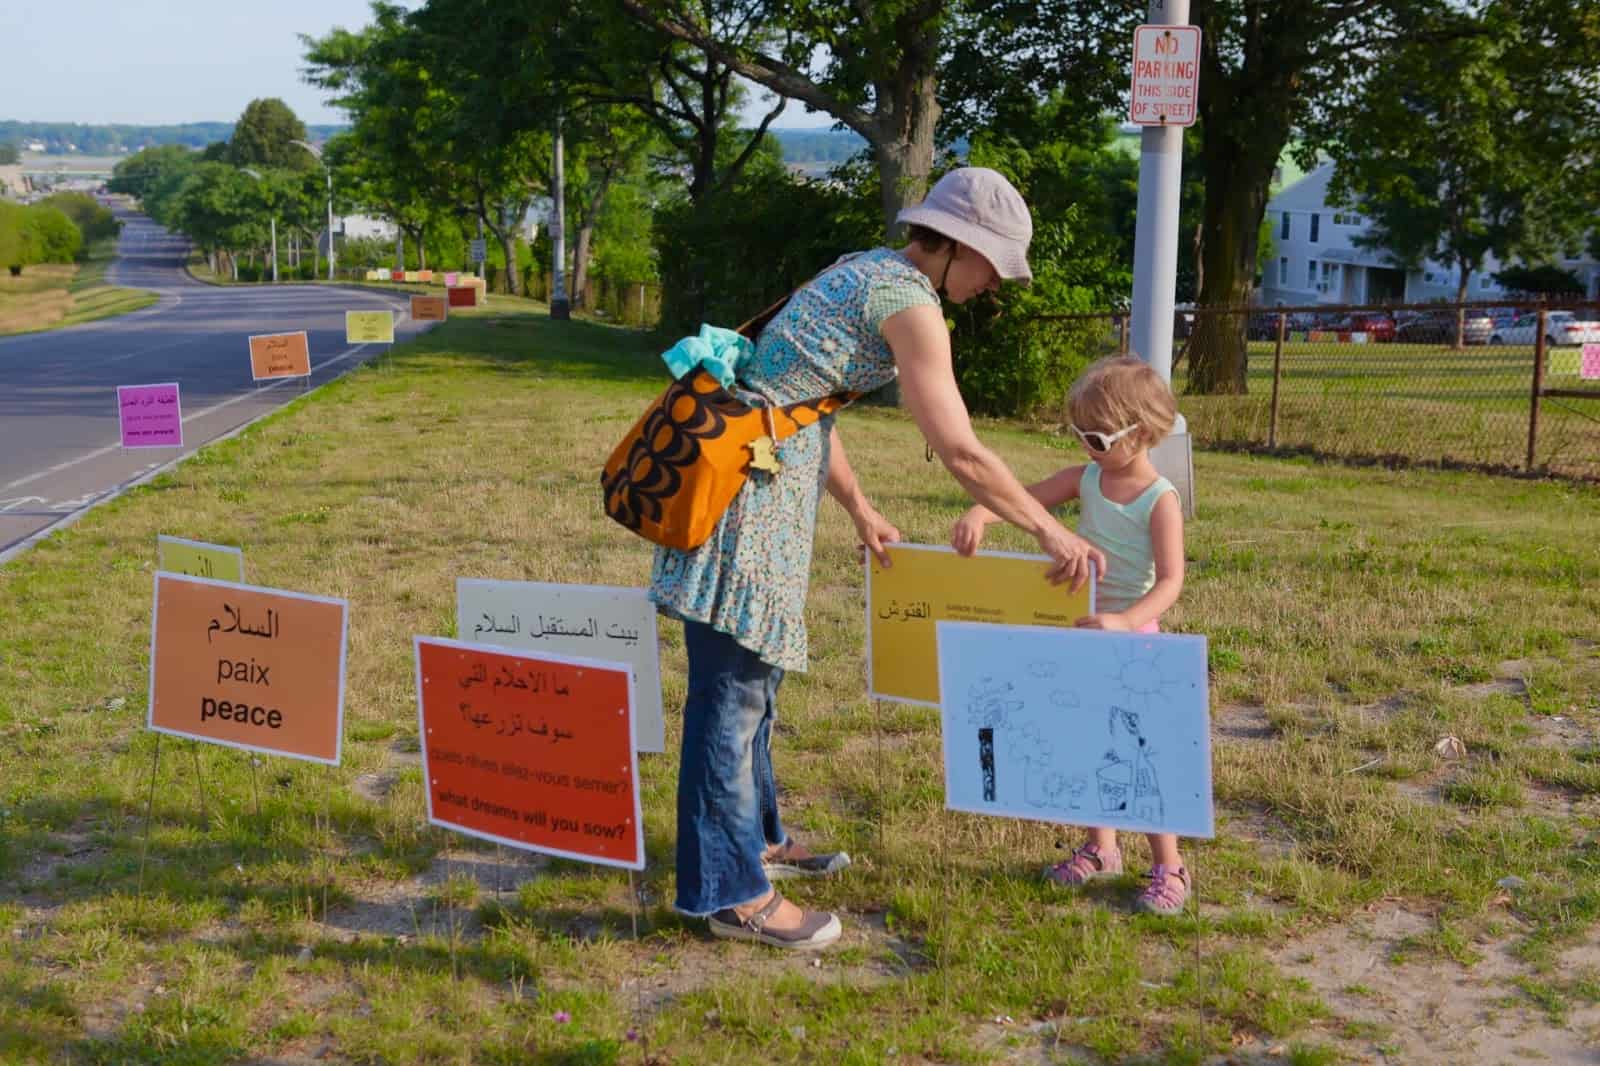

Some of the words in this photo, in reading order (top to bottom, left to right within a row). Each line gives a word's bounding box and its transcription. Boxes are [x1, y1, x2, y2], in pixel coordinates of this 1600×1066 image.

[1155, 37, 1179, 55] NO
[1137, 60, 1194, 79] PARKING
[1137, 84, 1161, 97] THIS
[1167, 85, 1192, 98] SIDE
[1134, 103, 1149, 114] OF
[1152, 103, 1193, 117] STREET
[208, 603, 279, 643] السلام
[474, 613, 521, 639] السلام
[530, 615, 599, 640] المستقبل
[606, 623, 639, 646] بيت
[217, 658, 270, 686] paix
[201, 697, 283, 729] peace
[472, 796, 520, 821] dreams
[523, 809, 547, 826] will
[551, 817, 579, 833] you
[584, 822, 625, 841] sow?
